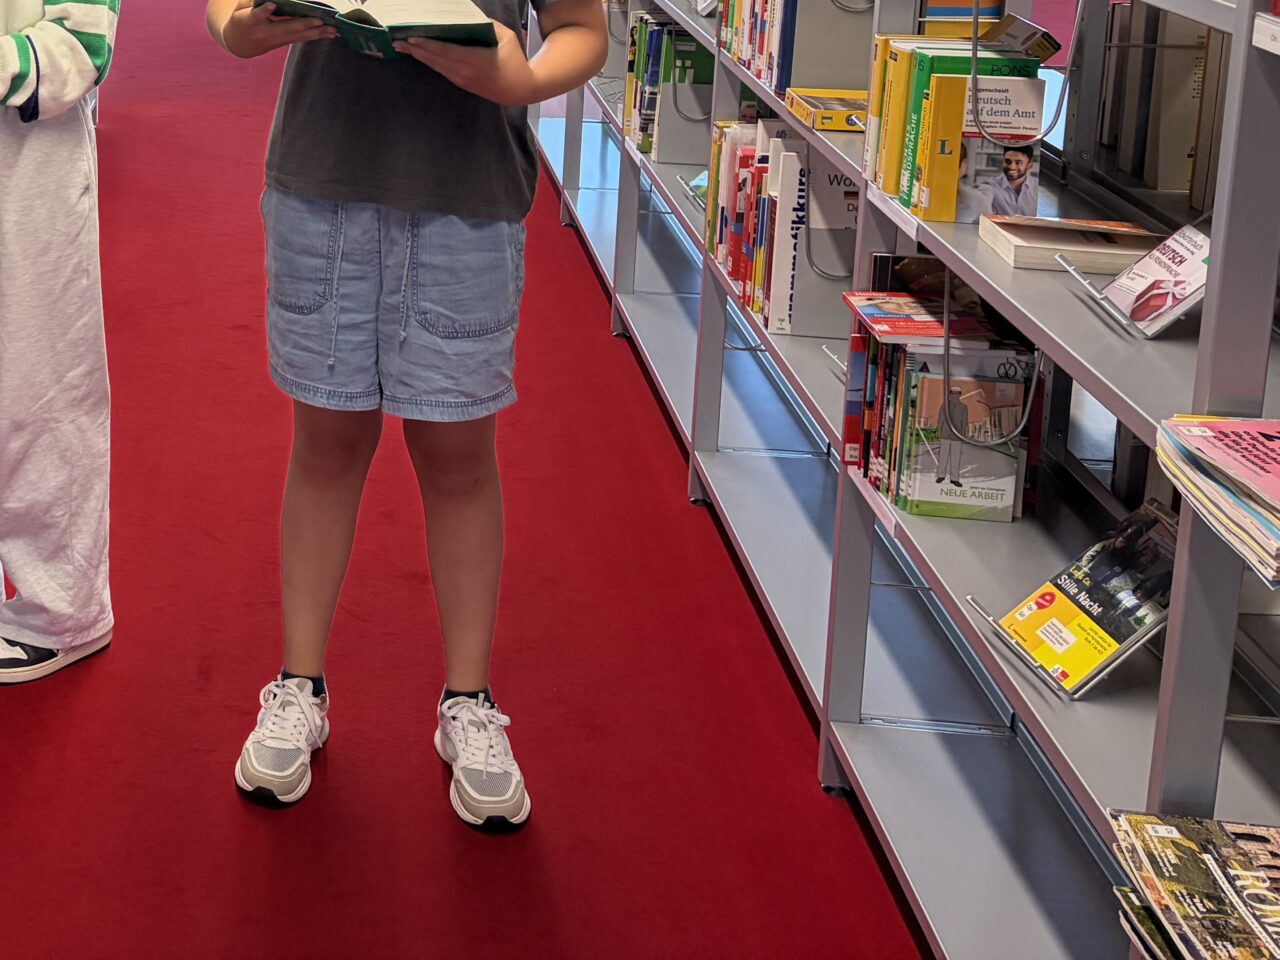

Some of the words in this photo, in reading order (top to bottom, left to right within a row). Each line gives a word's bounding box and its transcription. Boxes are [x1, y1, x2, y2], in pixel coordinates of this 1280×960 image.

[986, 107, 1010, 117] dem
[1012, 109, 1037, 119] Amt
[937, 139, 953, 156] L
[828, 173, 859, 187] Wor
[1156, 242, 1188, 268] DEUTSCH
[940, 487, 968, 499] NEUE
[970, 489, 1007, 502] ARBEIT
[1057, 574, 1078, 596] Stille
[1076, 589, 1104, 616] Nacht
